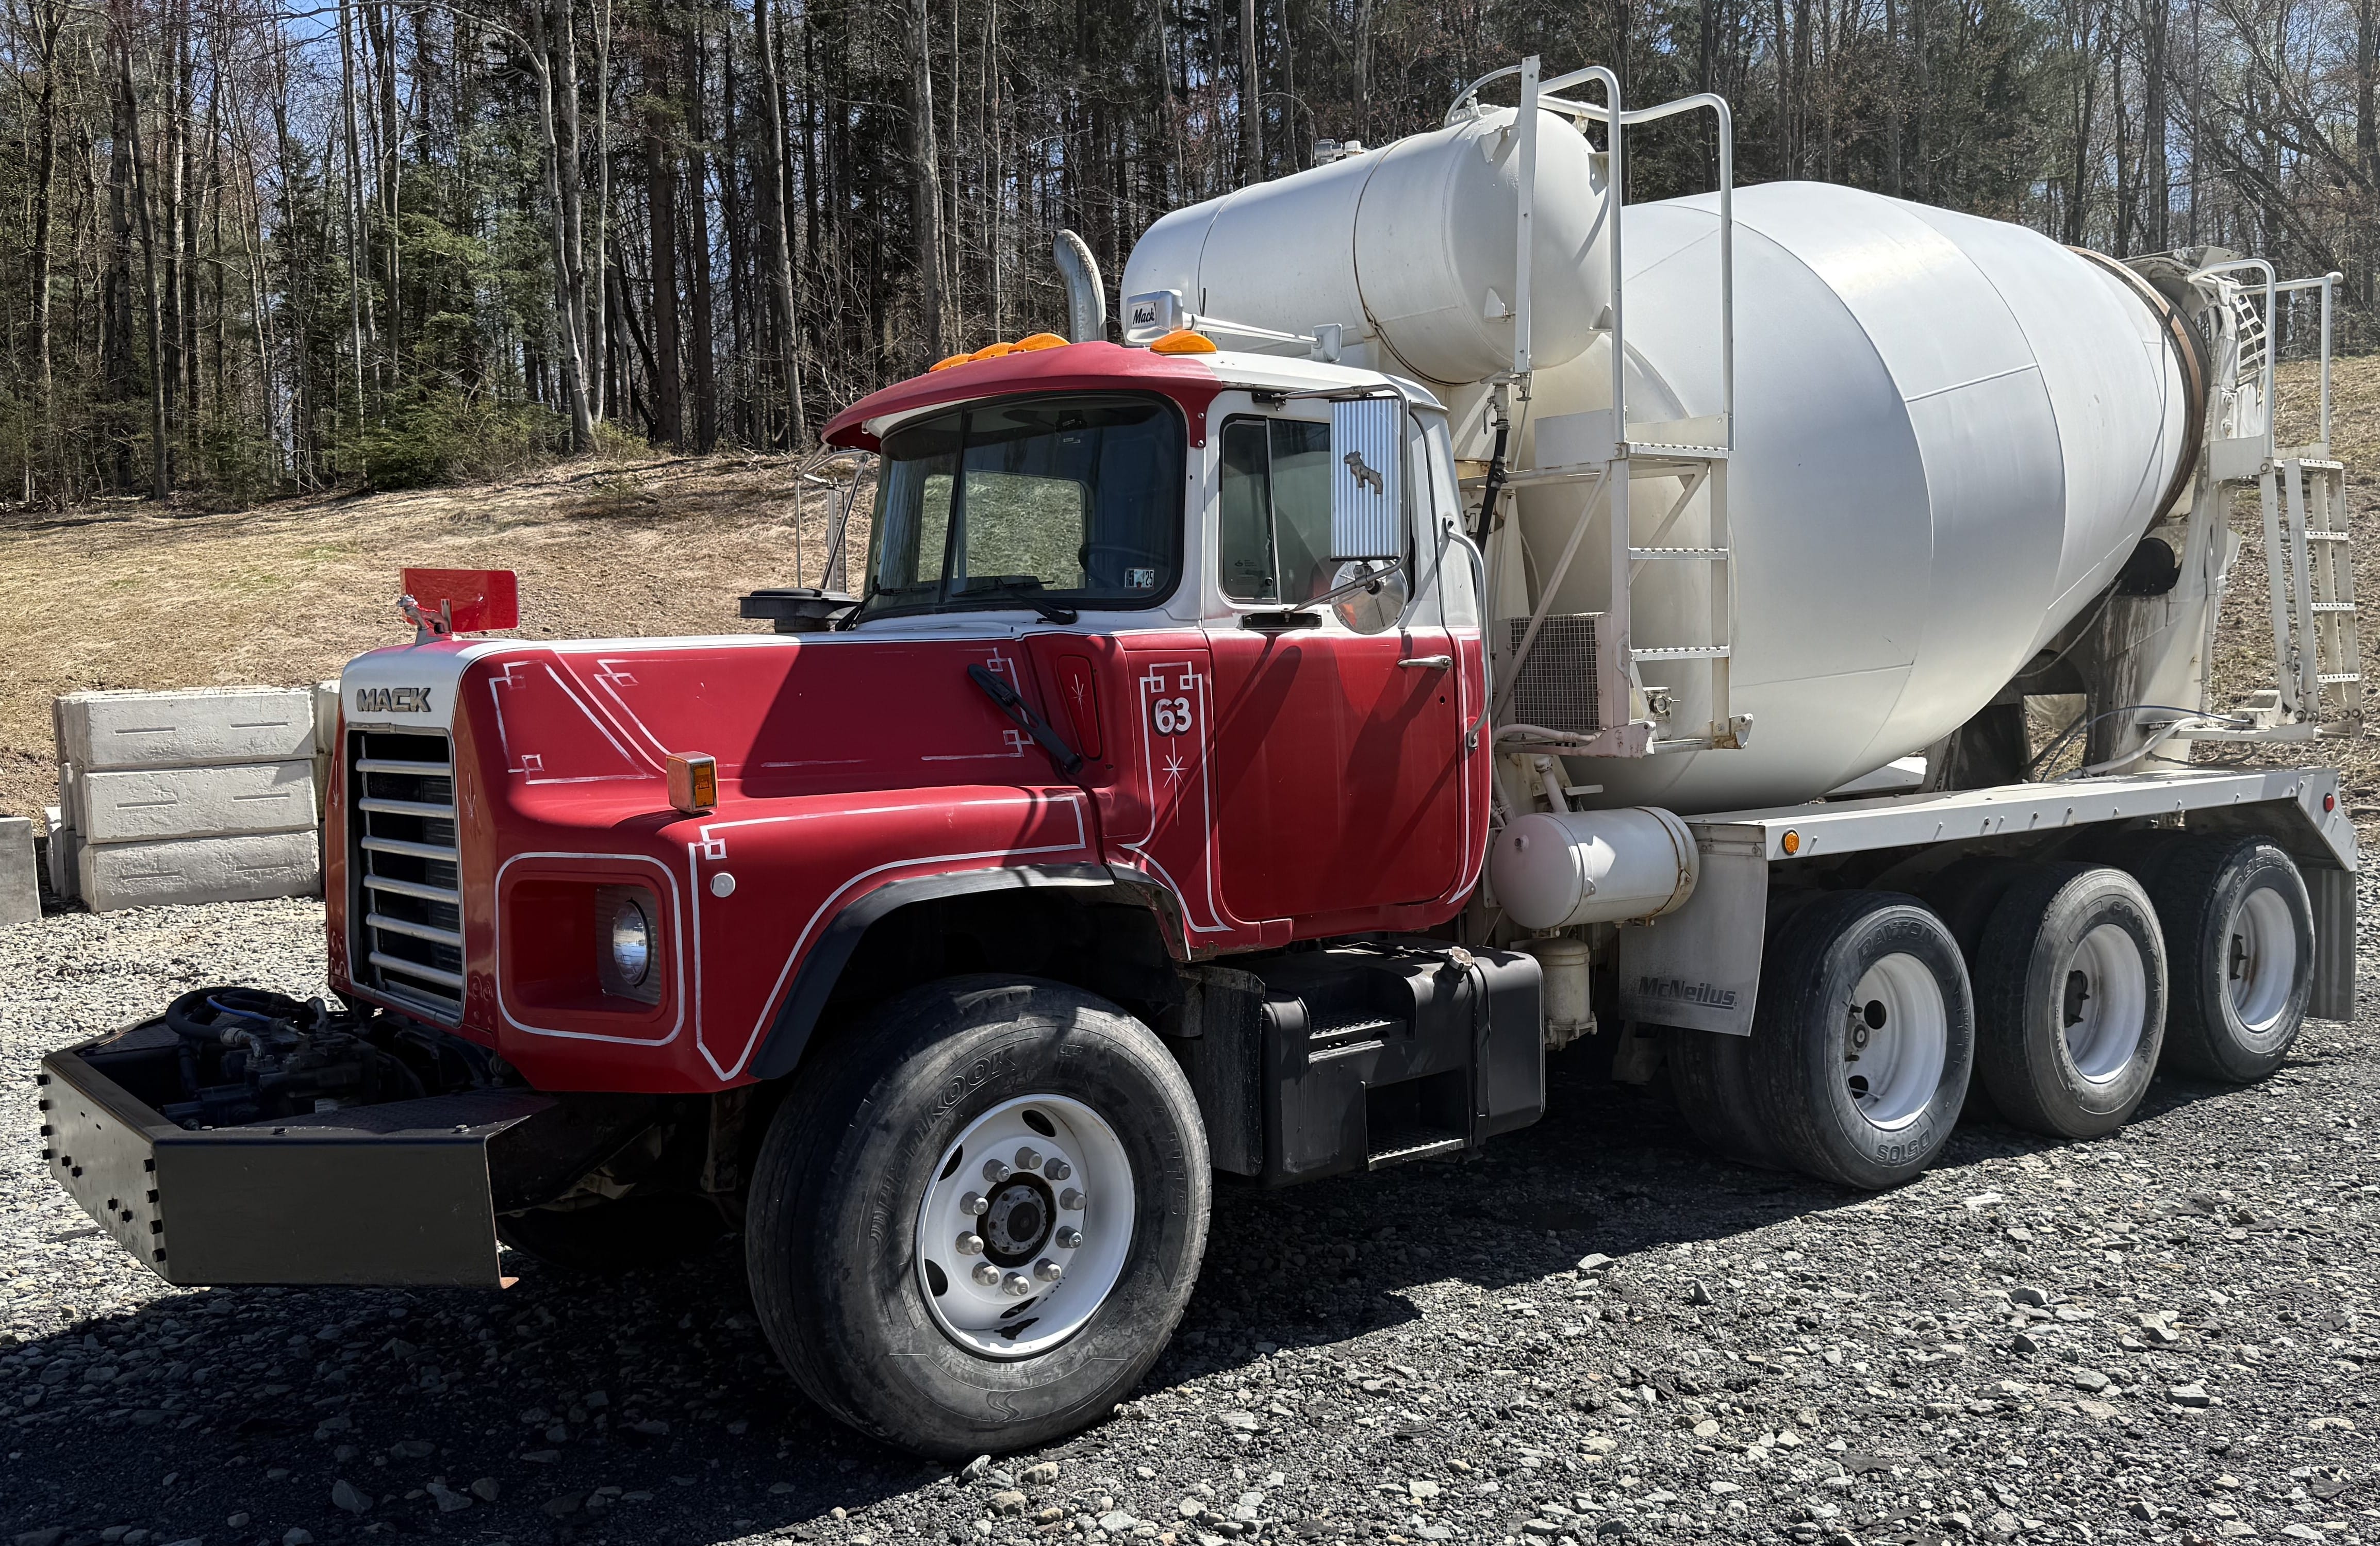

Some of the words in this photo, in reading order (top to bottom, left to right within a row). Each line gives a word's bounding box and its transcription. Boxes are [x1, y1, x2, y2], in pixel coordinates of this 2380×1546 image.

[1133, 308, 1154, 325] Mack
[1146, 571, 1153, 586] 25
[356, 688, 432, 712] MACK
[1153, 697, 1192, 734] 63
[1857, 920, 1939, 966] DAYTON
